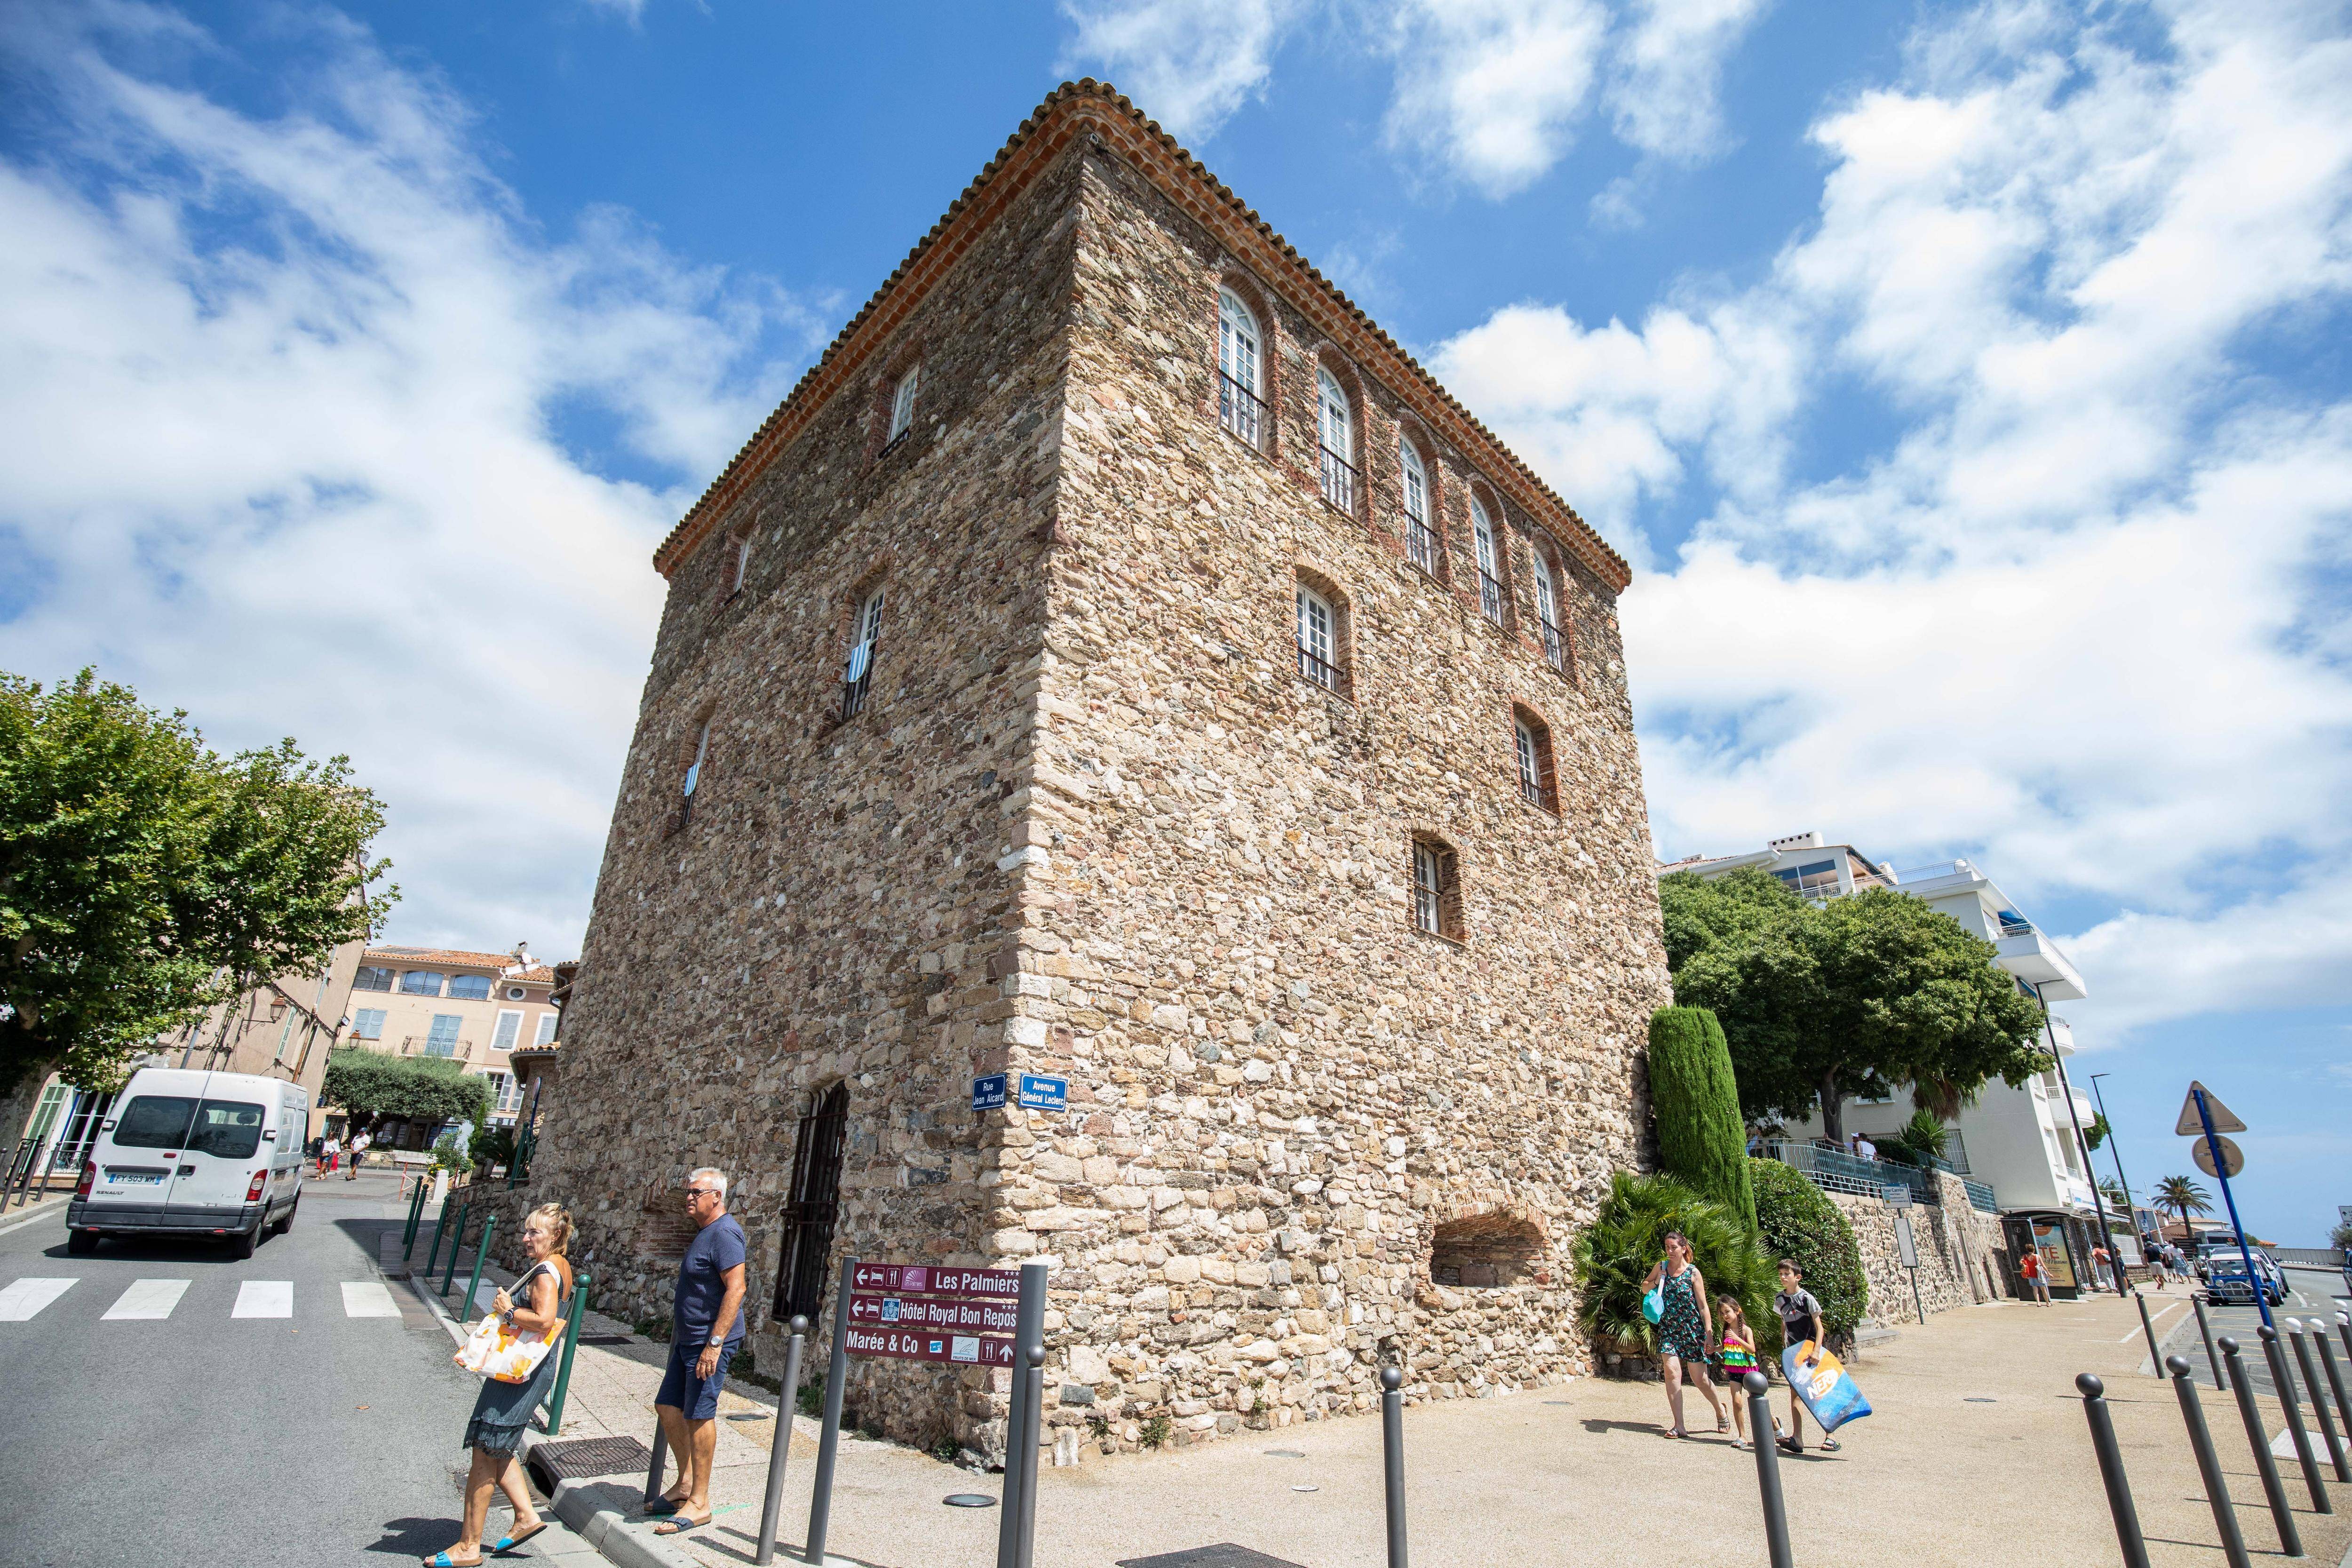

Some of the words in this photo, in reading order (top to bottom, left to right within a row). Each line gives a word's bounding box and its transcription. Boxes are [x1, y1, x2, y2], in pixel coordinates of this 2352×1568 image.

[983, 1082, 993, 1091] Rue
[1033, 1081, 1056, 1092] Avenue
[974, 1096, 985, 1105] Jean
[987, 1092, 1003, 1103] Aicard
[1022, 1091, 1043, 1103] Général
[1045, 1094, 1064, 1106] Leclerc
[936, 1272, 957, 1289] Les
[961, 1273, 1019, 1293] Palmiers
[900, 1302, 926, 1320] Hôtel
[929, 1304, 958, 1325] Royal
[960, 1306, 980, 1324] Bon
[984, 1308, 1017, 1329] Repos
[847, 1331, 884, 1350] Marée
[888, 1334, 898, 1352] &
[902, 1335, 918, 1353] Co
